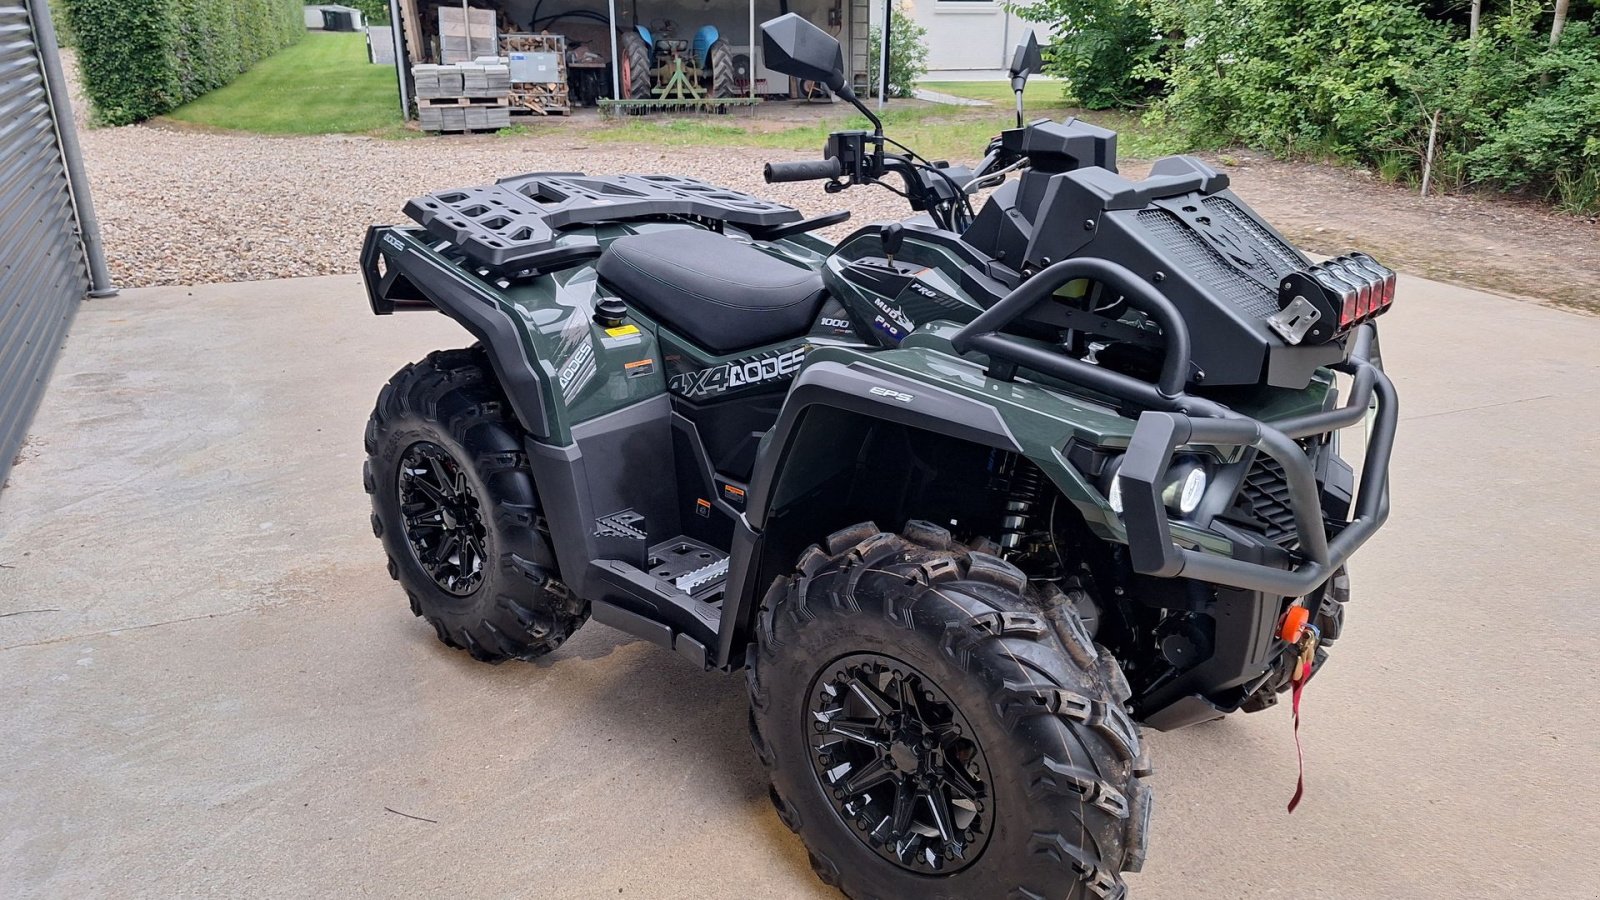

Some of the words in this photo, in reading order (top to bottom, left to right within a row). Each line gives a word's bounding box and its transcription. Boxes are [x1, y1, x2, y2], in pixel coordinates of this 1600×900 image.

[911, 283, 937, 298] PRO
[874, 298, 899, 319] MUD
[821, 317, 850, 328] 1000
[875, 315, 898, 335] Pro
[559, 342, 592, 389] AODES
[869, 386, 914, 403] EPS
